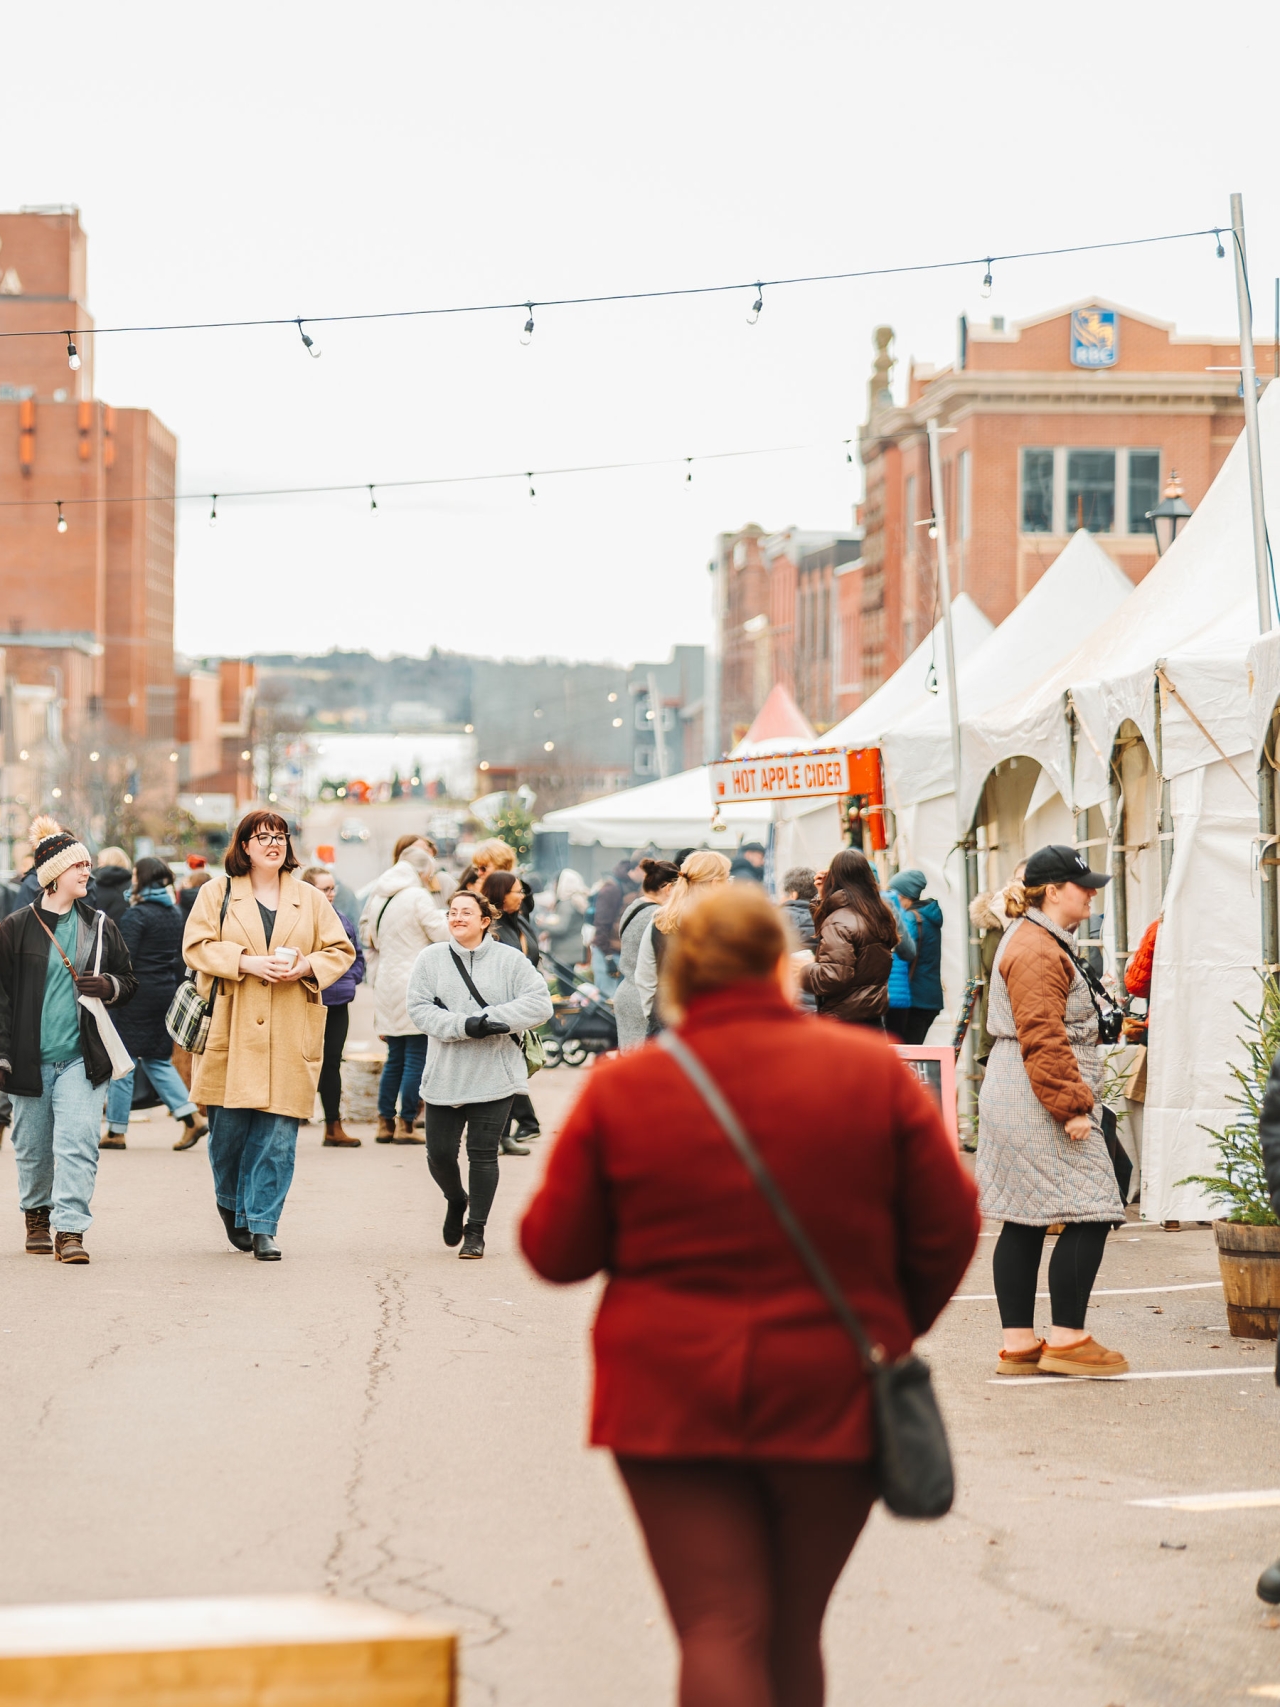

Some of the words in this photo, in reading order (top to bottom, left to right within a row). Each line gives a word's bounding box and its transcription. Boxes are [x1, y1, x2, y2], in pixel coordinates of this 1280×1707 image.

[1076, 346, 1115, 364] RBC
[732, 769, 756, 794] HOT
[761, 765, 800, 792] APPLE
[804, 762, 843, 788] CIDER
